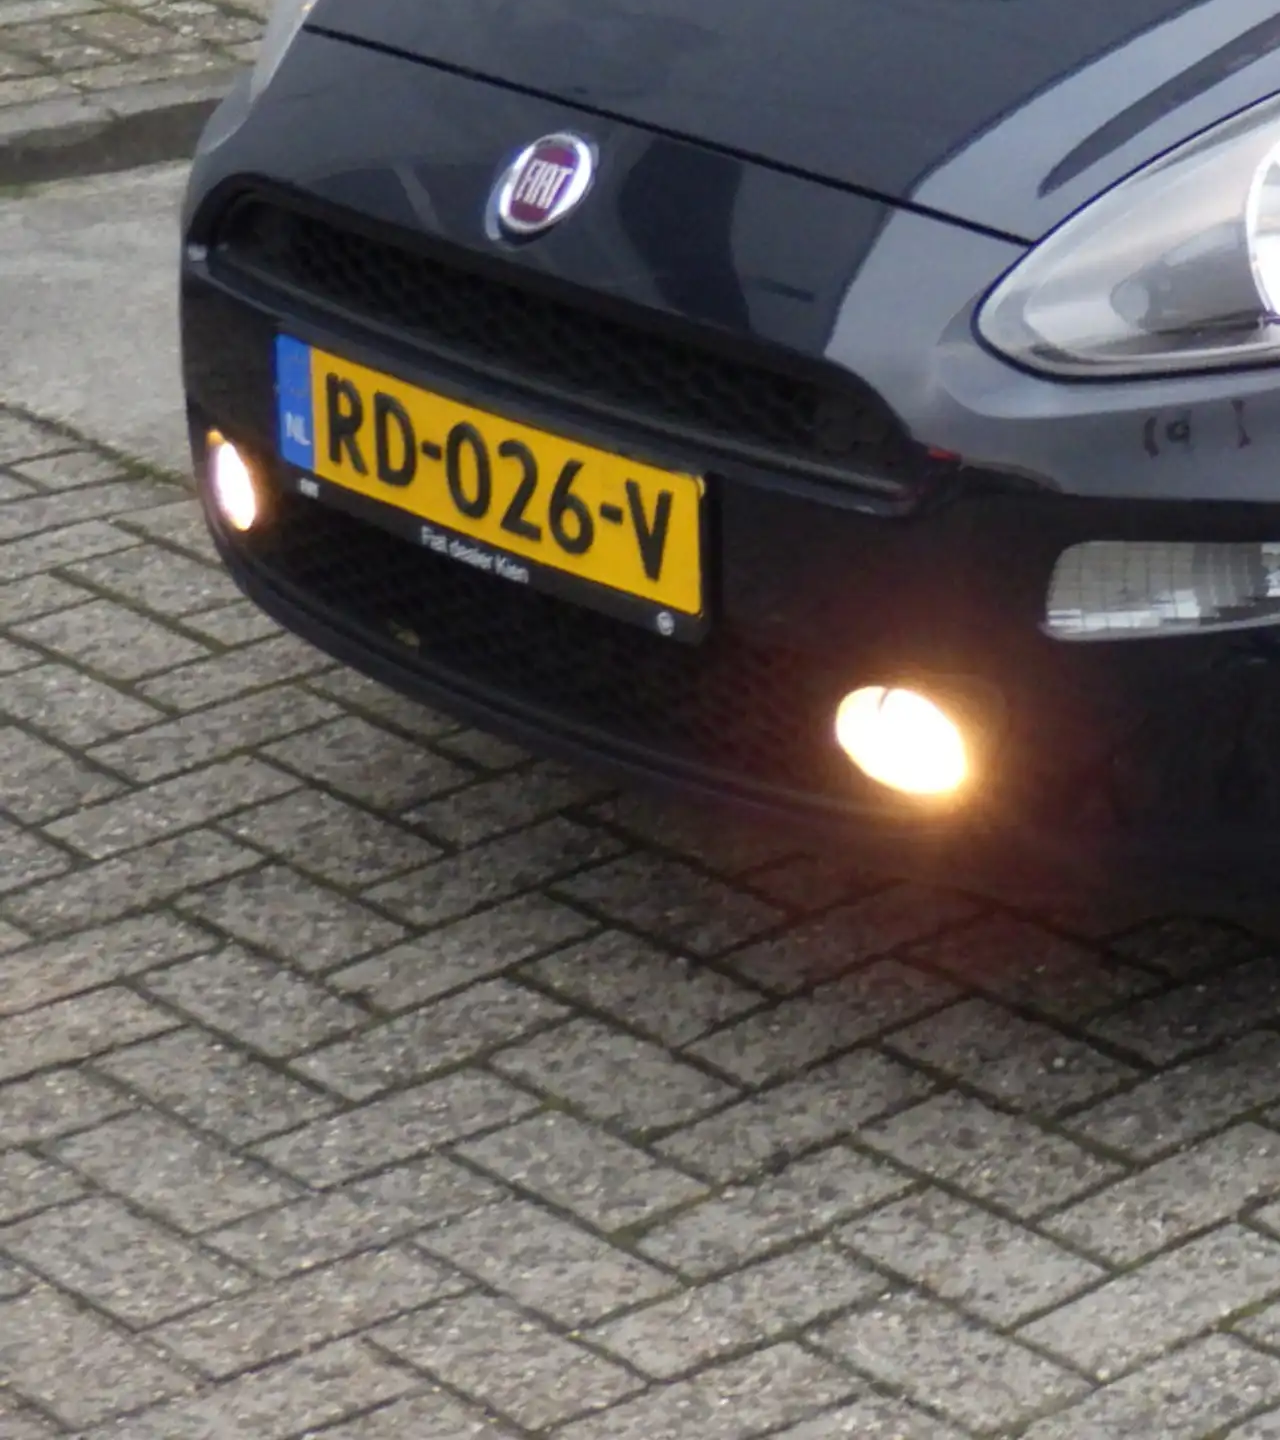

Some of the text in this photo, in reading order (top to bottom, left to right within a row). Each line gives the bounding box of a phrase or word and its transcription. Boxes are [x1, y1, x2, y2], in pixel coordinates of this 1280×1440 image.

[514, 158, 574, 210] FIAT
[285, 410, 311, 446] NL
[325, 371, 673, 583] RD-026-V
